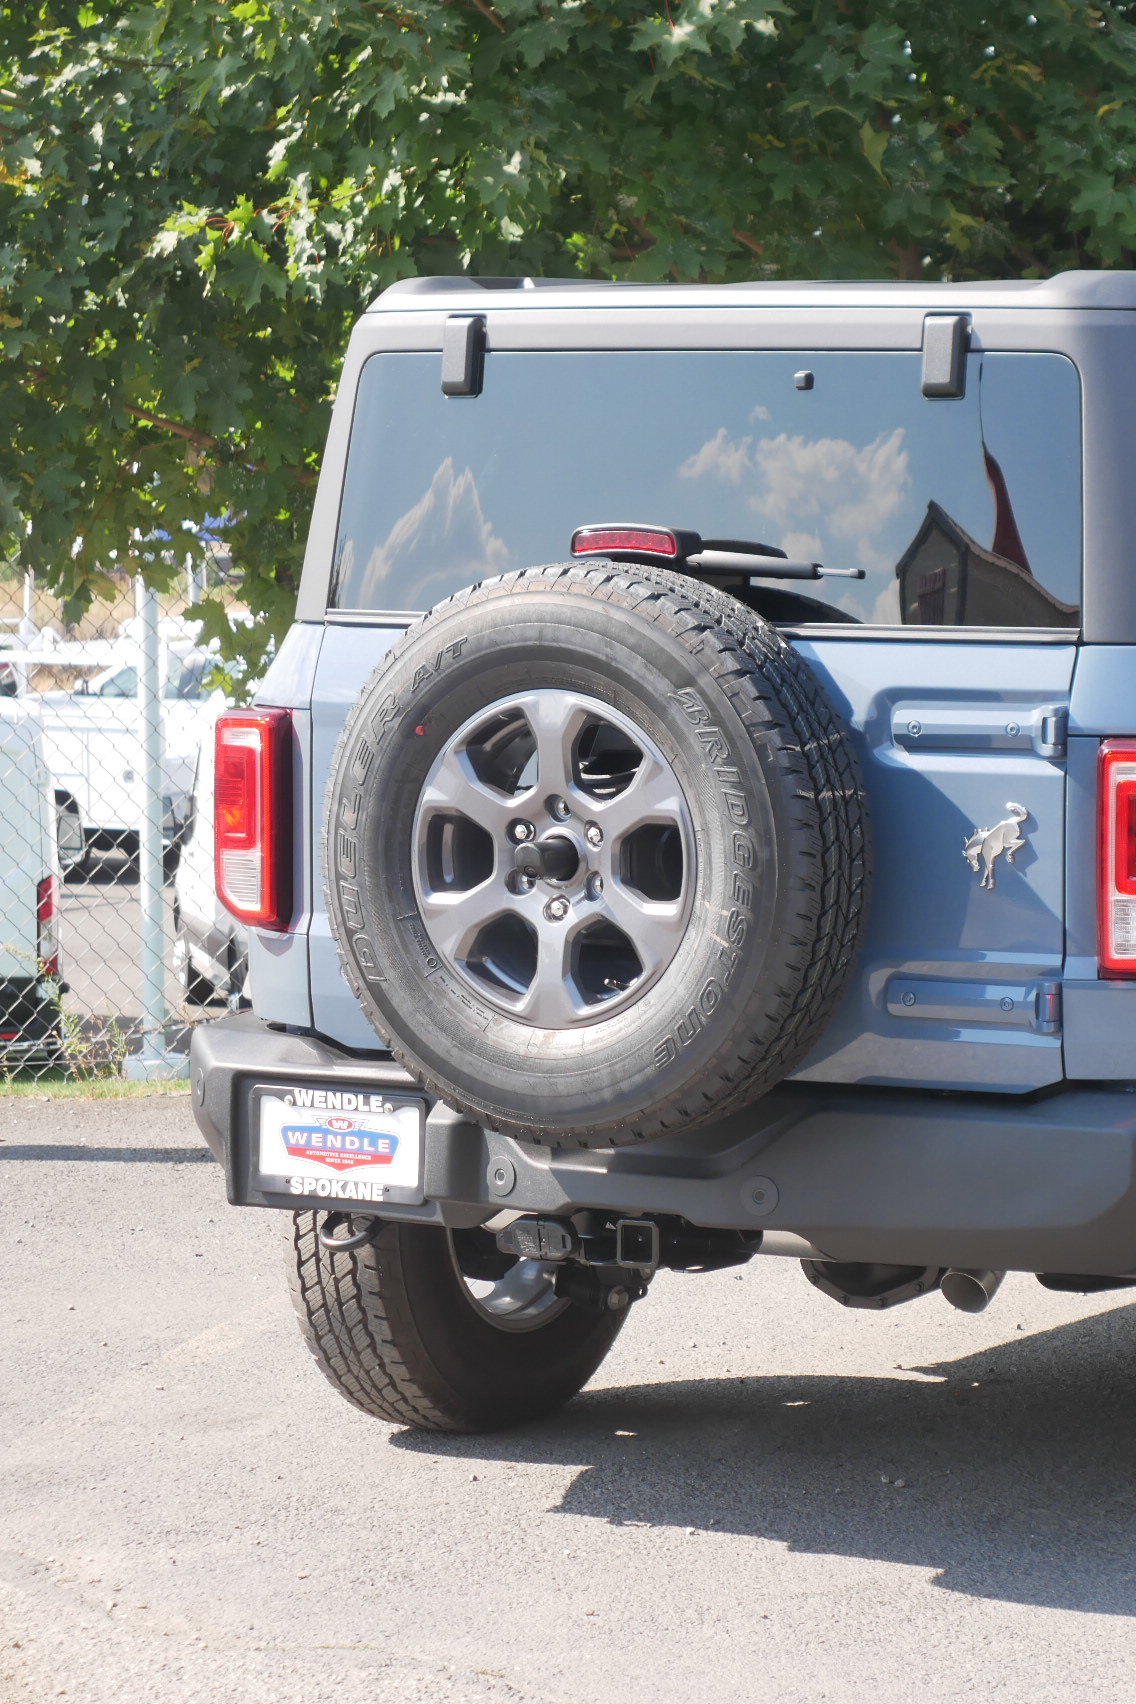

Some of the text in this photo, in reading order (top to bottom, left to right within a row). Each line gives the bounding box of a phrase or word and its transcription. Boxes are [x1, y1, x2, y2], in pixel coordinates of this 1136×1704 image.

[338, 636, 468, 983] DUELER A/T
[651, 686, 755, 1070] BRIDGESTONE
[294, 1089, 384, 1113] WENDLE
[332, 1120, 348, 1130] W
[288, 1131, 390, 1152] WENDLE
[306, 1150, 372, 1160] AUTOMOTIVE EXCELLENCE
[290, 1177, 384, 1201] SPOKANE
